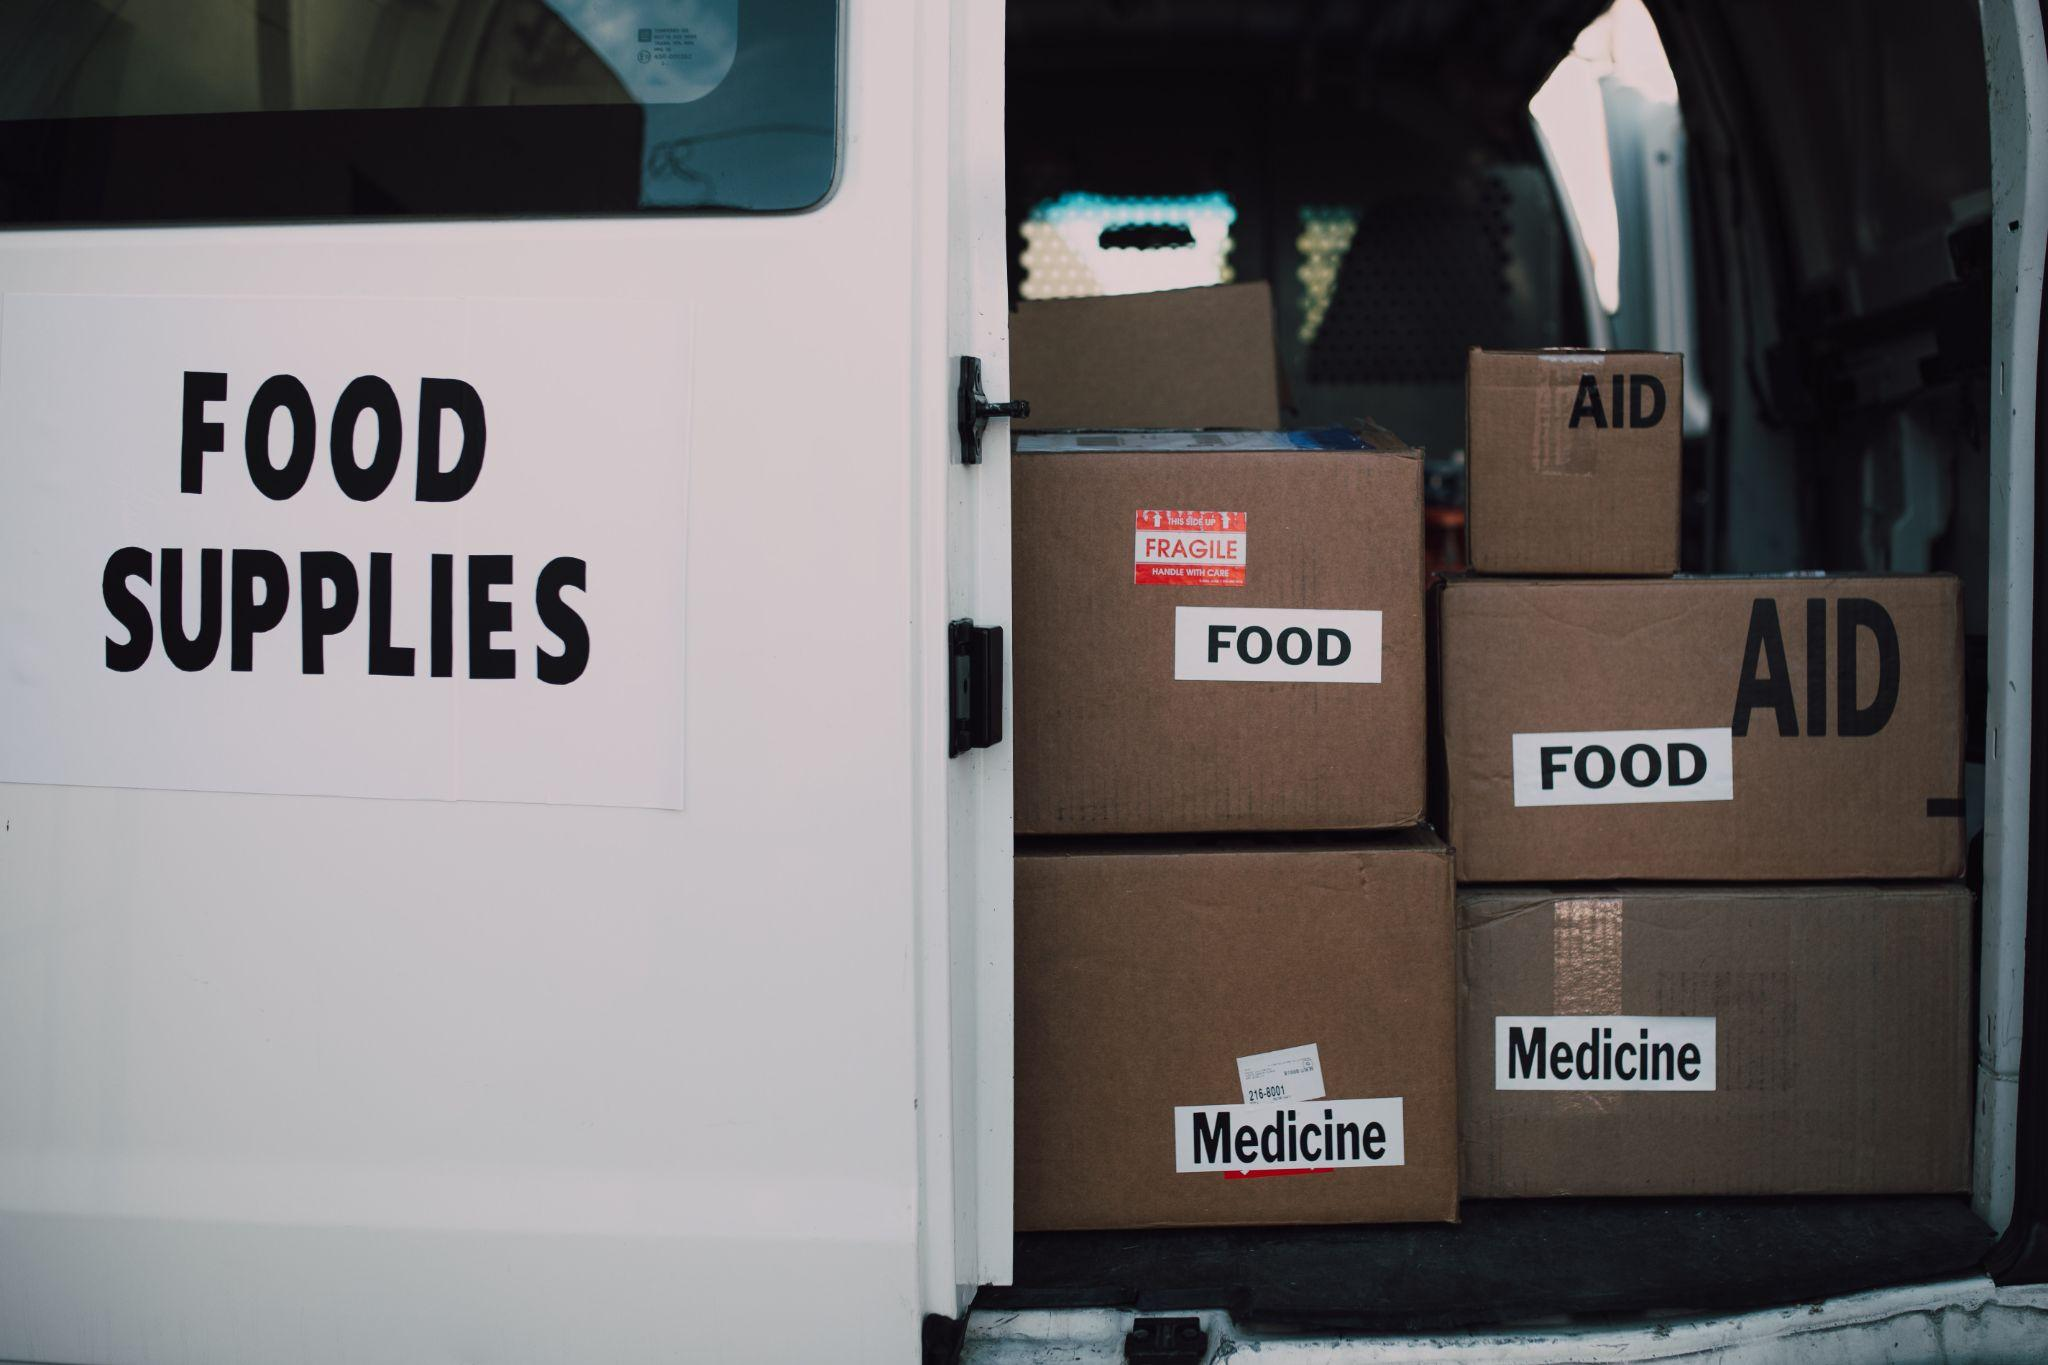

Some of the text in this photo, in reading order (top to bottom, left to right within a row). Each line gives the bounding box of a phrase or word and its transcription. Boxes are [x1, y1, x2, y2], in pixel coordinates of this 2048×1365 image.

[1568, 374, 1667, 429] AID
[181, 371, 486, 502] FOOD
[1168, 517, 1216, 526] THIS SIDE UP
[1145, 538, 1237, 559] FRAGILE
[1152, 568, 1230, 577] HANDLE WITH CARE
[102, 547, 589, 685] SUPPLIES
[1208, 625, 1352, 666] FOOD
[1732, 598, 1900, 737] AID
[1541, 743, 1707, 789] FOOD
[1508, 1027, 1701, 1081] Medicine
[1249, 1085, 1285, 1101] 216-8001
[1193, 1109, 1386, 1164] Medicine
